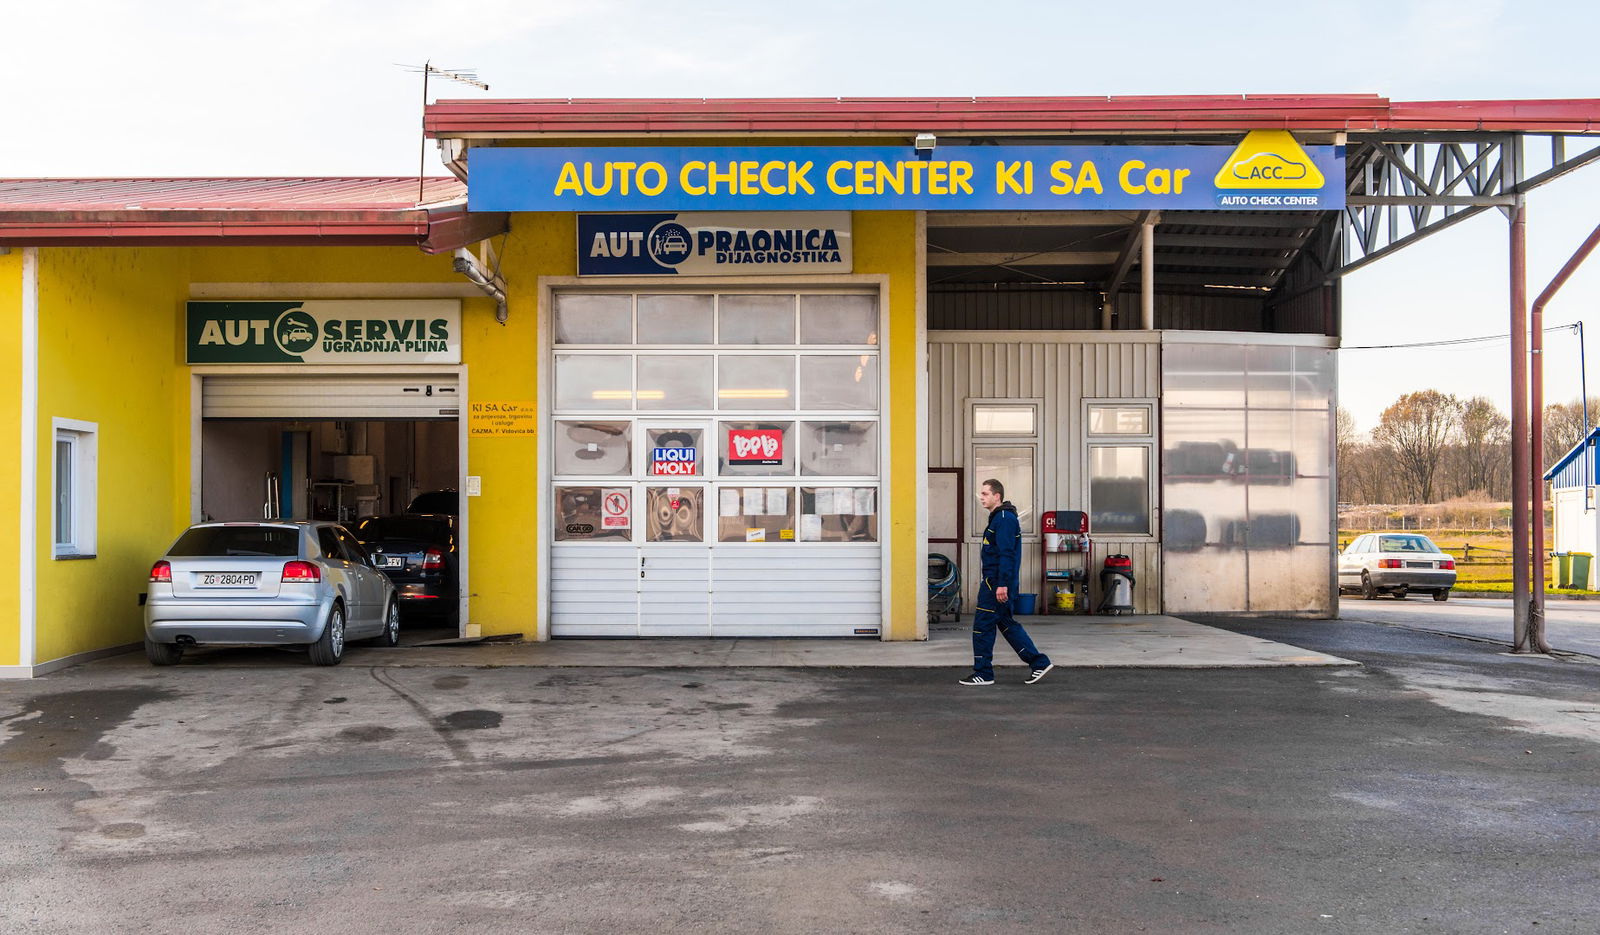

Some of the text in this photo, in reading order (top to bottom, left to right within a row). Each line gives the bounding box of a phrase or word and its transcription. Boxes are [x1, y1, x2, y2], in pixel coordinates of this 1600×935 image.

[553, 160, 1191, 196] AUTO CHECK CENTER KI SA Car
[1250, 166, 1283, 180] ACC
[1221, 196, 1318, 206] AUTO CHECK CENTER
[697, 229, 840, 256] PRAONICA
[715, 251, 842, 264] DIJAGNOSTIKA
[323, 319, 449, 344] SERVIS
[323, 340, 449, 353] UGRADNJA PLINA
[472, 403, 482, 412] KI
[485, 403, 499, 412] SA
[501, 403, 518, 412] Car
[655, 449, 694, 462] LIQUI
[655, 462, 694, 474] MOLY
